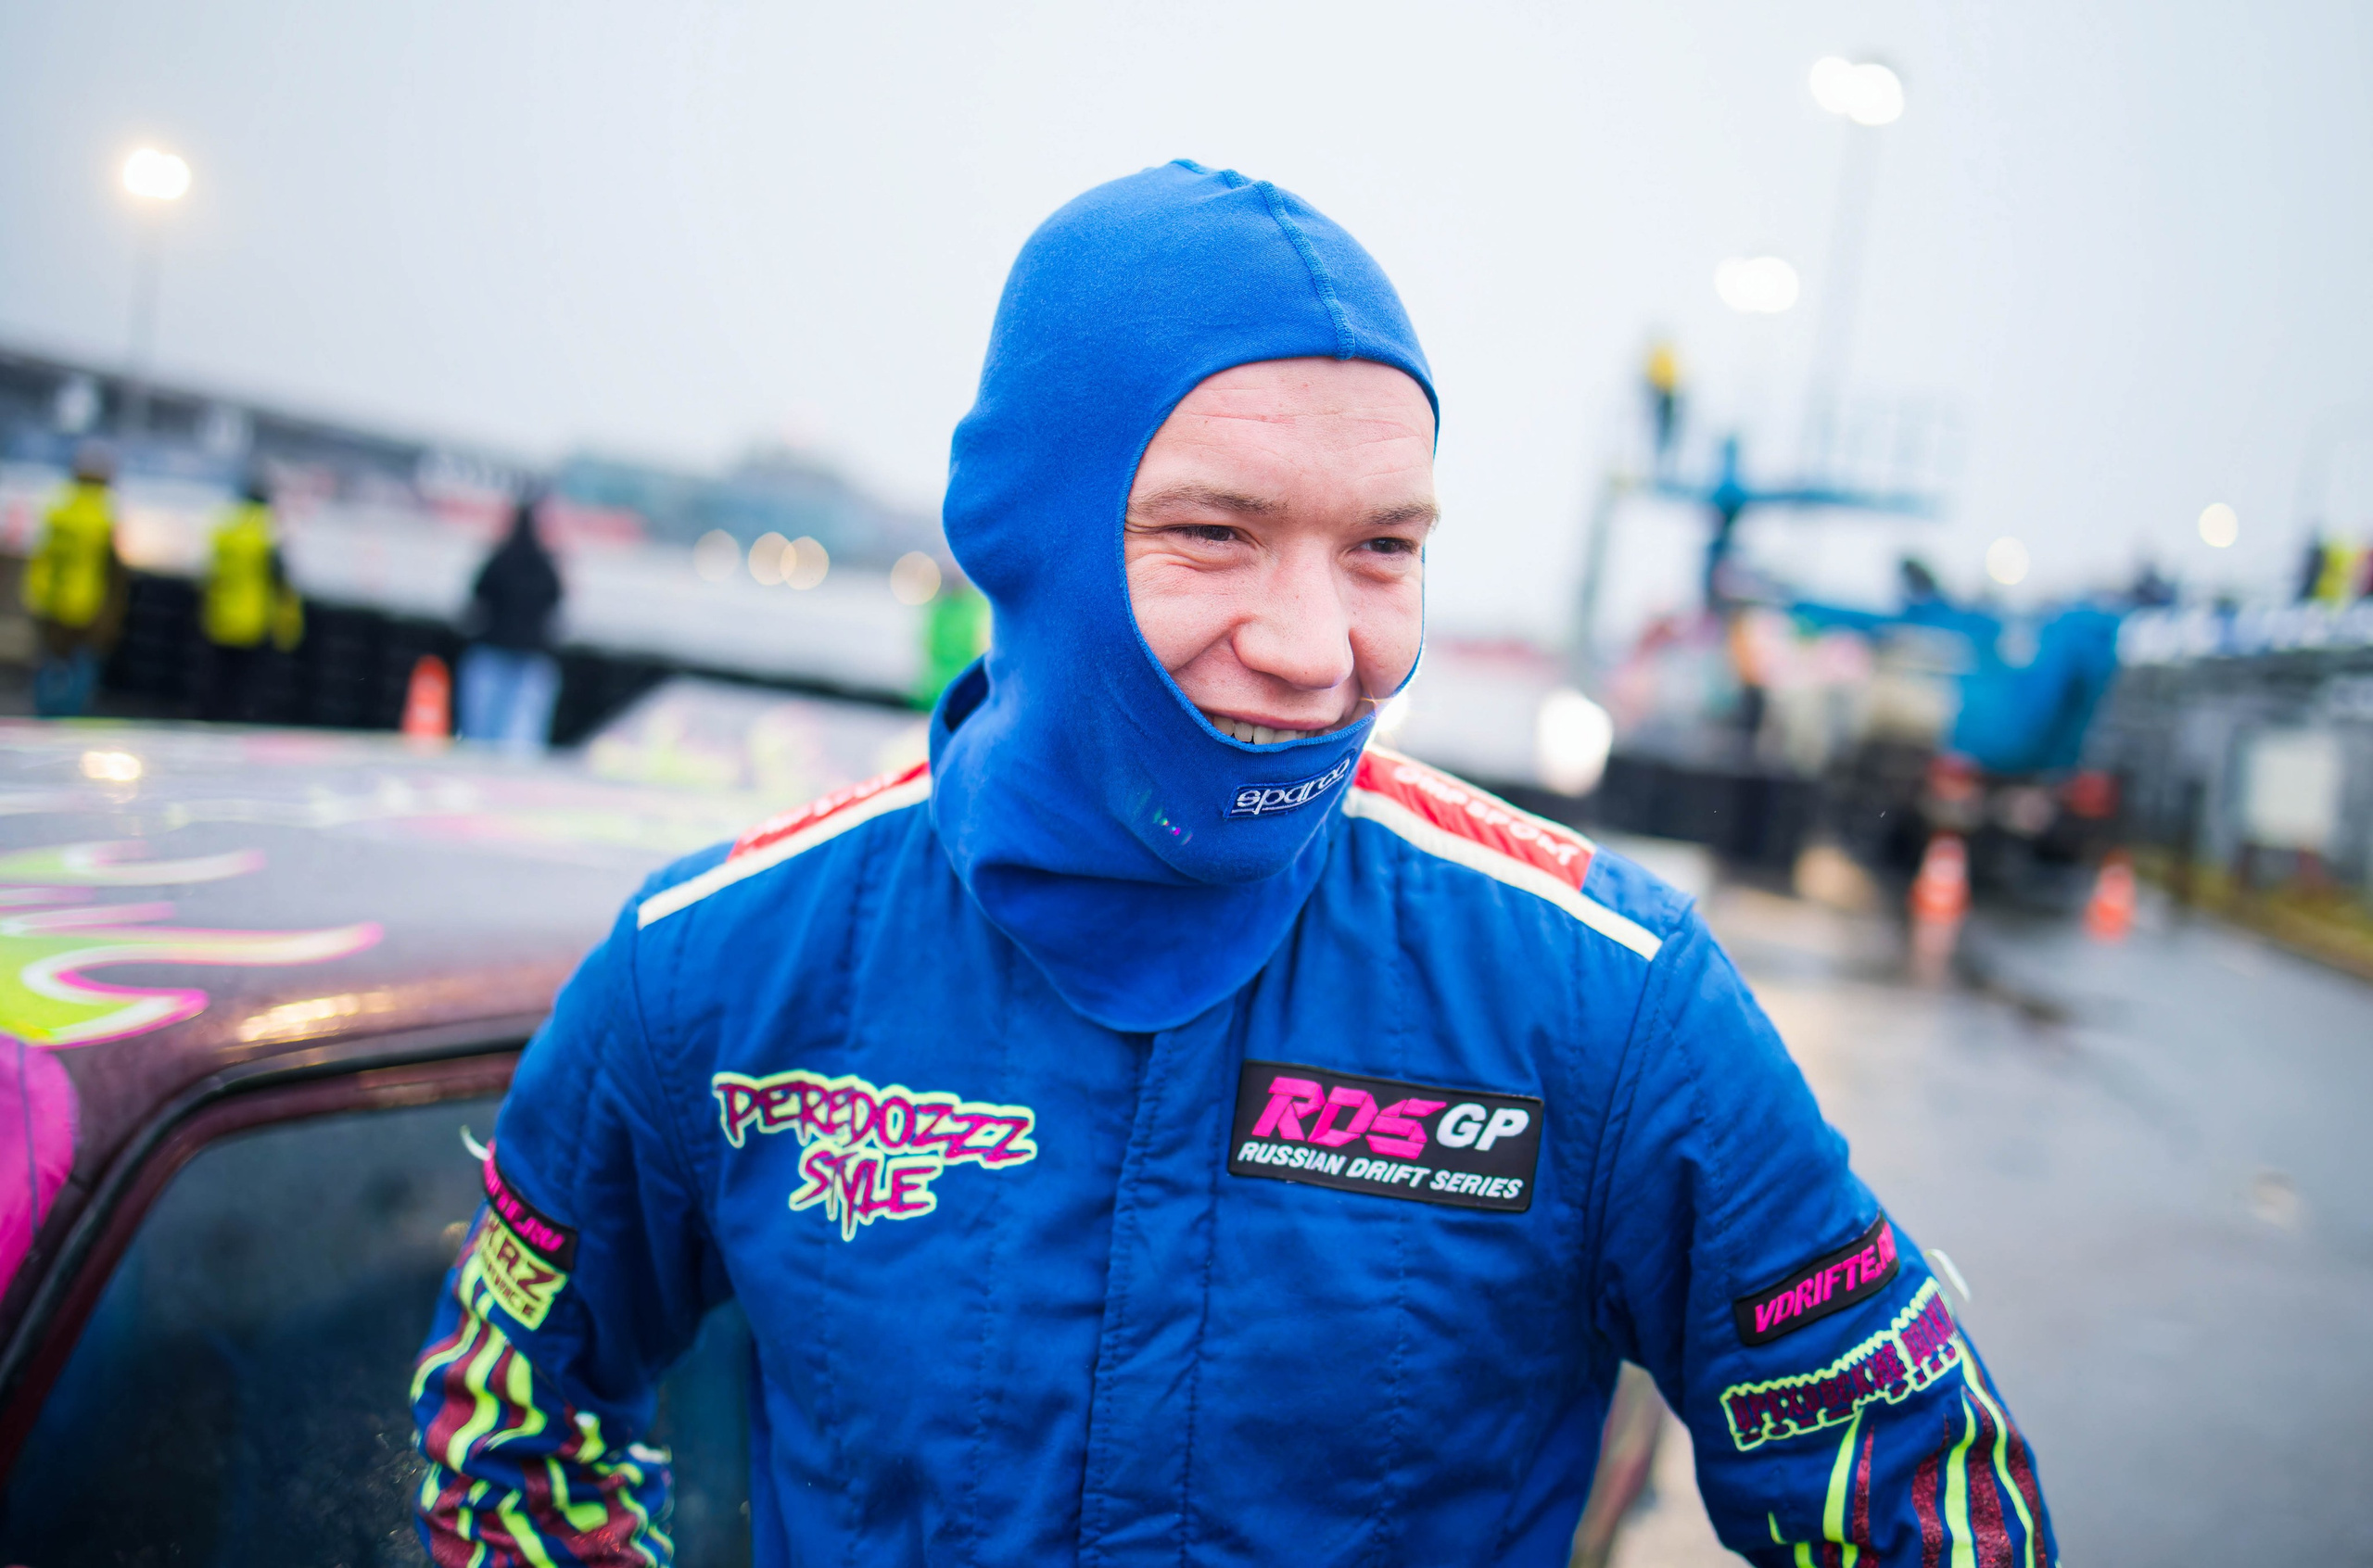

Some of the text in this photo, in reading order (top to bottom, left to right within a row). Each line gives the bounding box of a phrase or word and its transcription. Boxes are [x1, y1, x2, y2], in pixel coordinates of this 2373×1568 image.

[1237, 758, 1351, 815] sparco
[713, 1070, 1036, 1168] PEREDOZZZ
[1251, 1076, 1529, 1159] RDS GP
[793, 1145, 942, 1239] STYLE
[1237, 1141, 1525, 1200] RUSSIAN DRIFT SERIES
